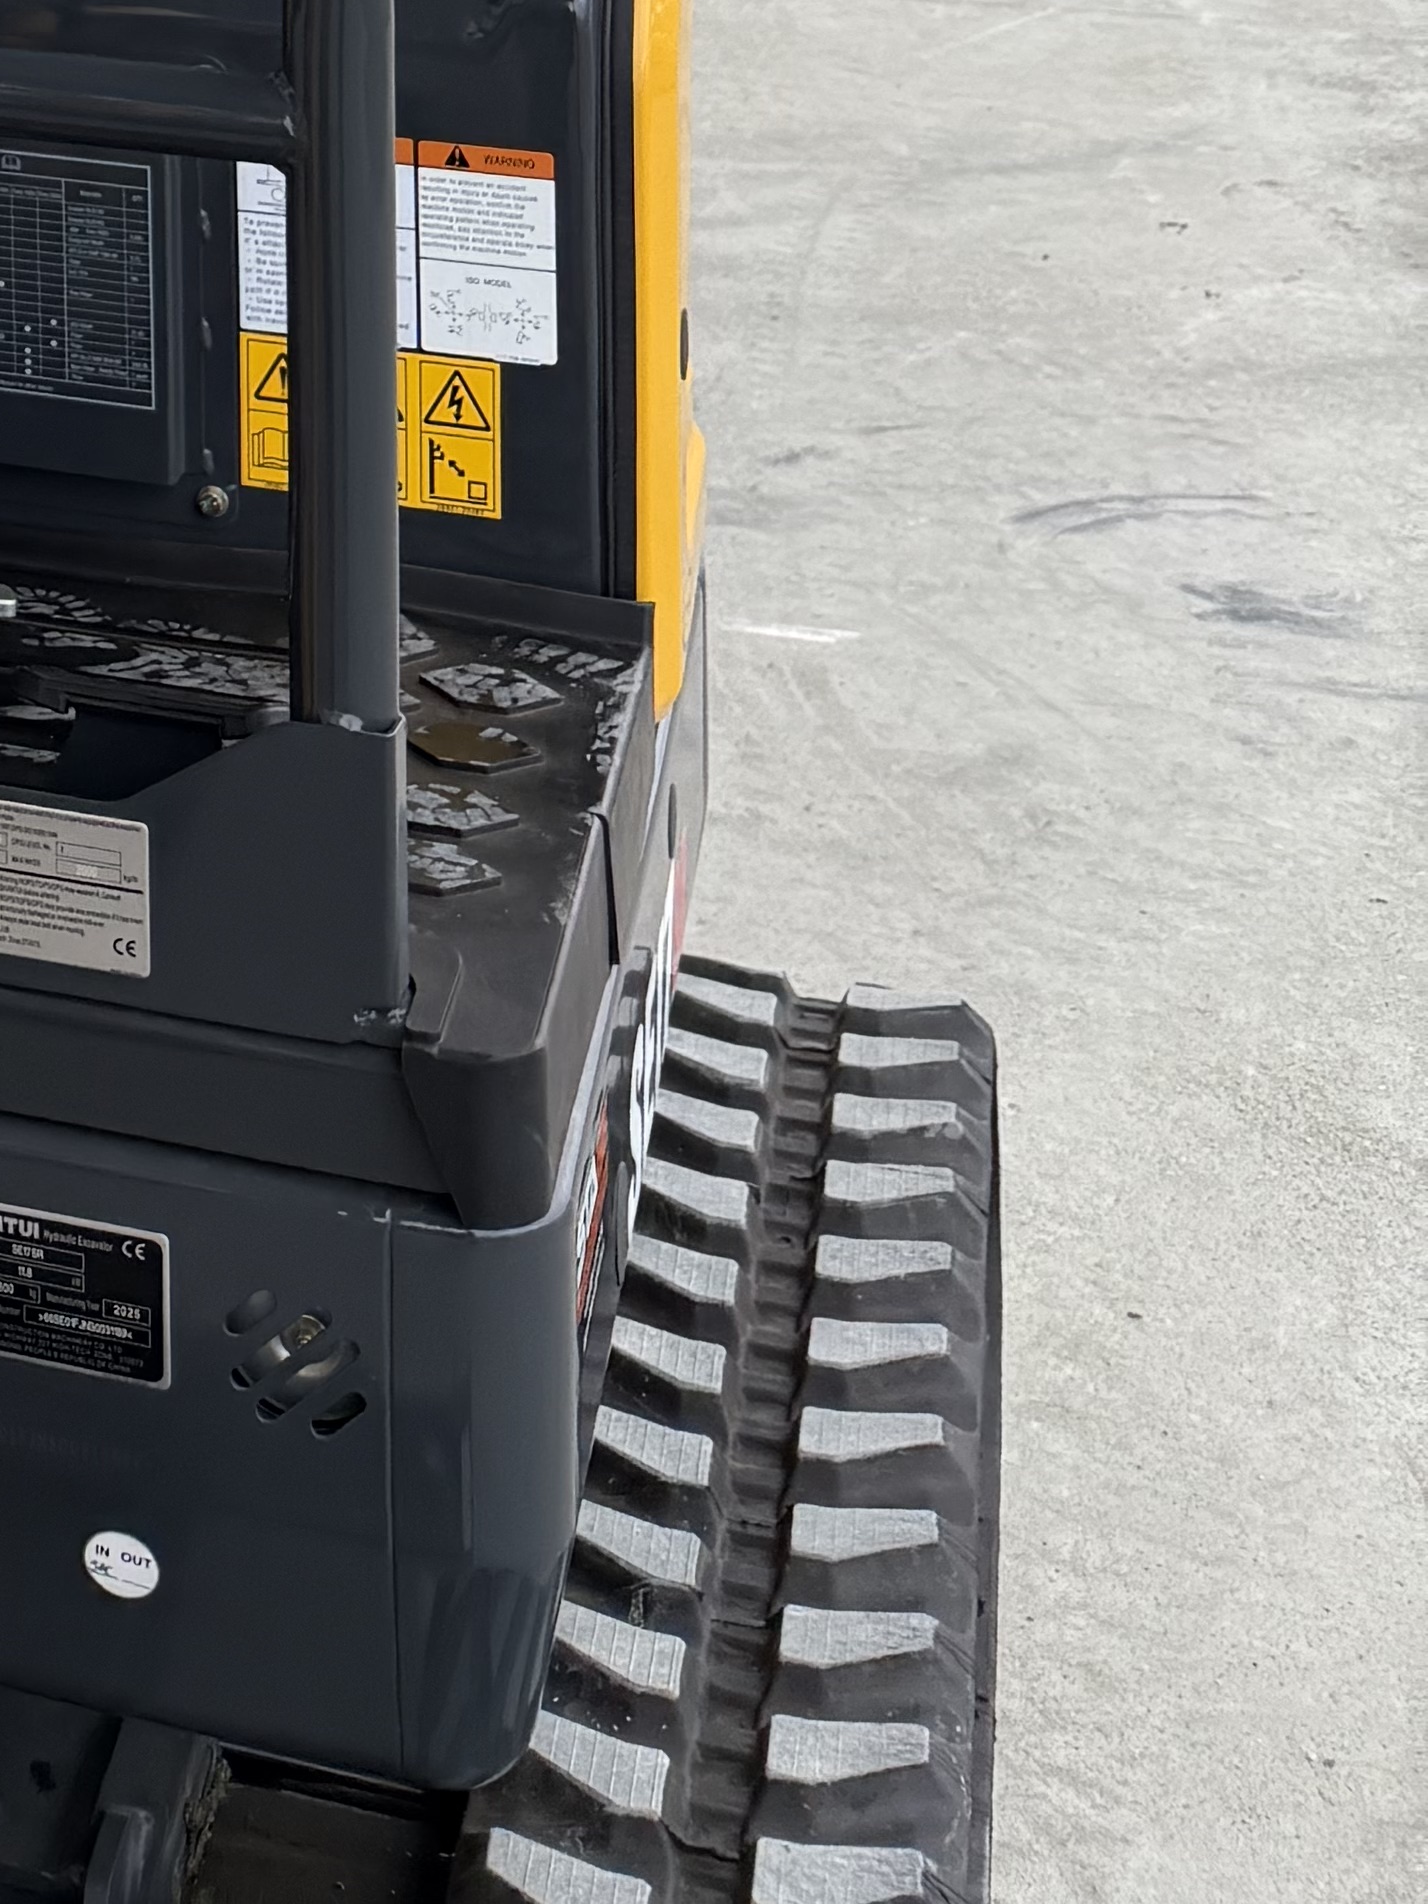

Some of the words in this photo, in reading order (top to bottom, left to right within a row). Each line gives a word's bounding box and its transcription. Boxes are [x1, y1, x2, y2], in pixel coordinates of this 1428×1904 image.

[483, 154, 536, 171] WARNING
[112, 1303, 142, 1321] 2025
[95, 1543, 111, 1558] IN
[120, 1551, 153, 1570] OUT
